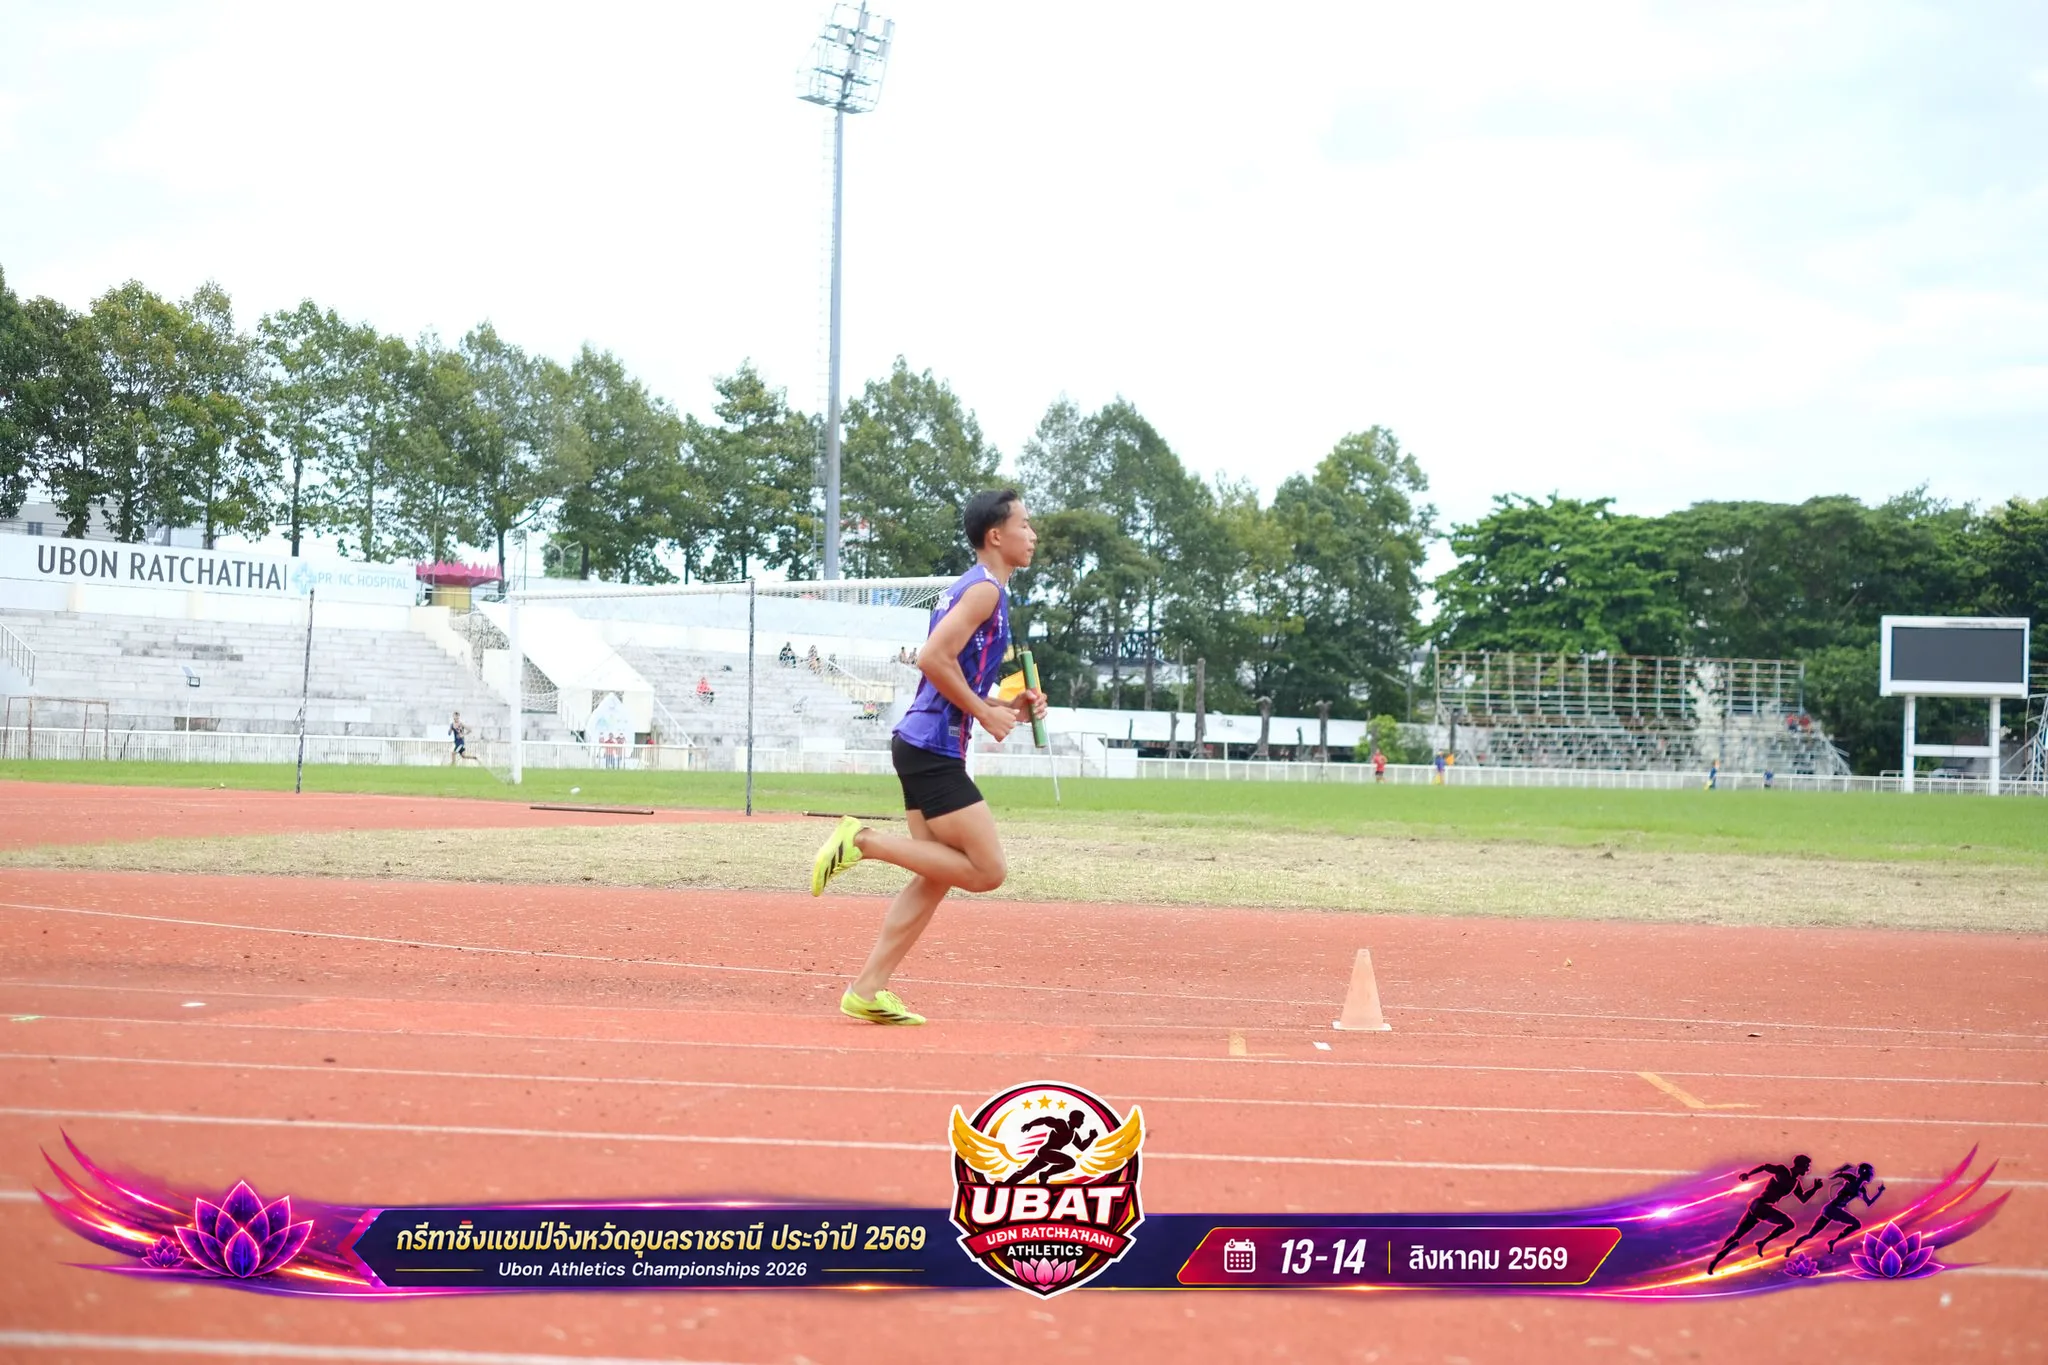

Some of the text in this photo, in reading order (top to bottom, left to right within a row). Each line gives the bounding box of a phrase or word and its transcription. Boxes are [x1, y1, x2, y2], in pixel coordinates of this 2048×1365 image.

[37, 544, 118, 579] UBON
[317, 571, 409, 591] PRNC HOSPITAL
